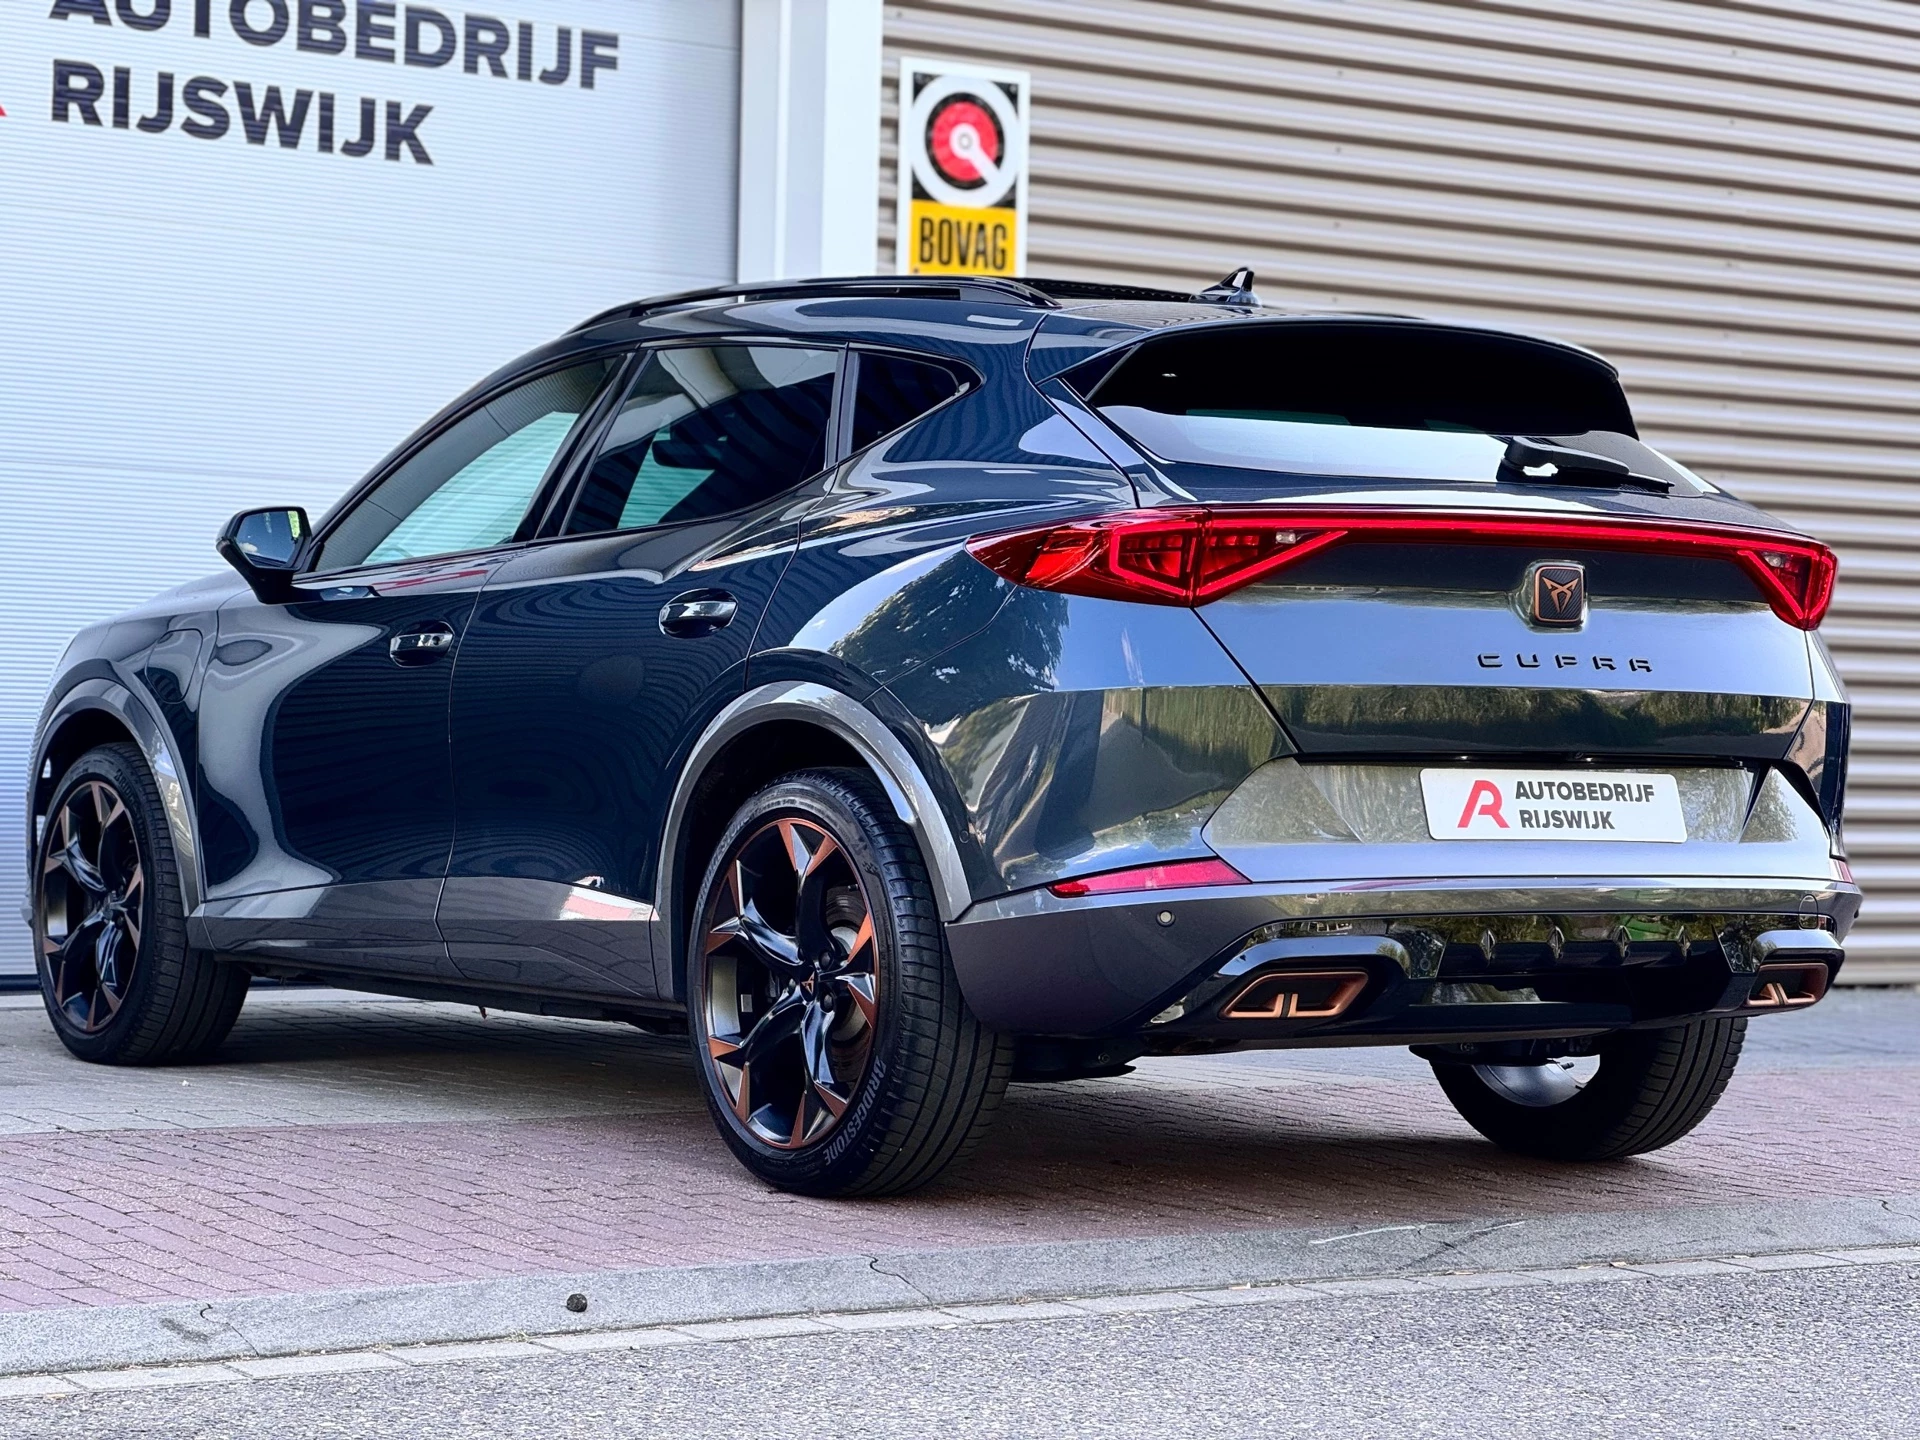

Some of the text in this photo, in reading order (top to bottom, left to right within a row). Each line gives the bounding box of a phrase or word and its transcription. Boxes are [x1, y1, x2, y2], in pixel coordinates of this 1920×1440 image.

[51, 59, 434, 165] RIJSWIJK
[919, 217, 1007, 270] BOVAG
[1477, 653, 1653, 673] CUPRA
[1515, 781, 1655, 802] AUTOBEDRIJF
[1519, 809, 1616, 830] RIJSWIJK
[823, 1055, 887, 1166] BRIDGESTONE
